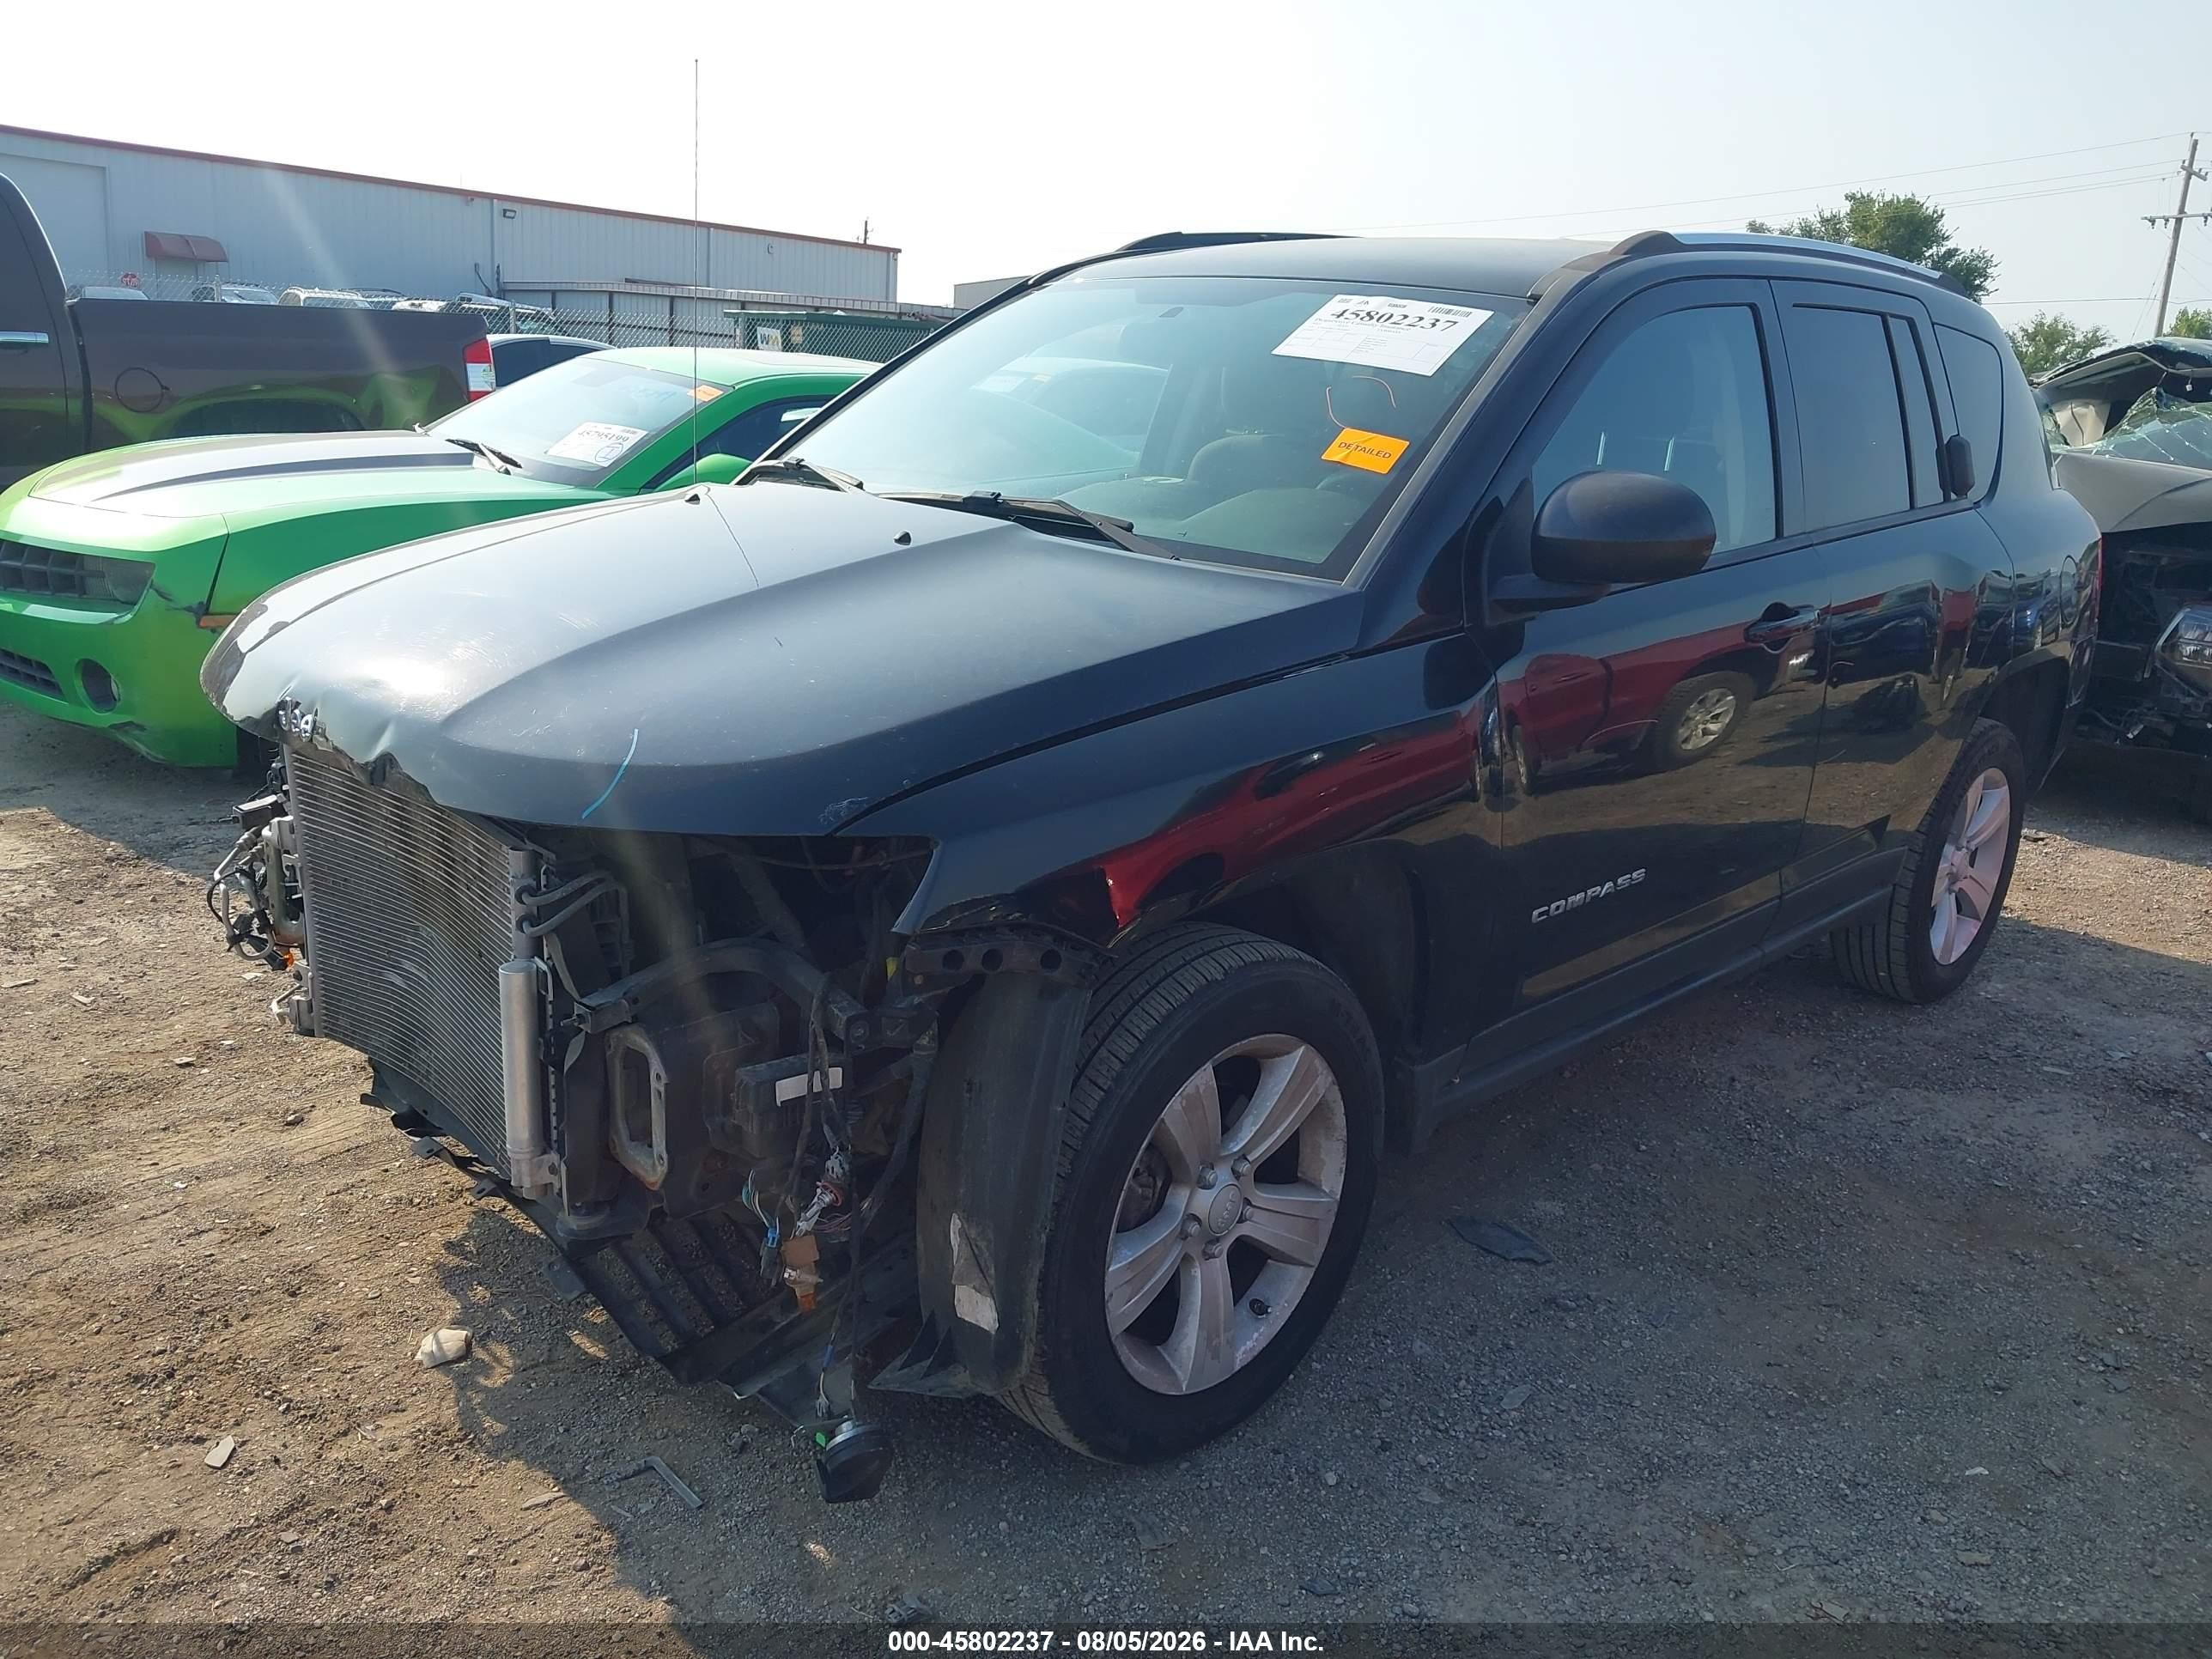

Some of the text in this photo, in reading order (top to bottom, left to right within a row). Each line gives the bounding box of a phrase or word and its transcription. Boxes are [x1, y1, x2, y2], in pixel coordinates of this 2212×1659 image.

[1331, 307, 1459, 332] 45802237
[1338, 441, 1392, 459] DETAILED
[1531, 868, 1646, 924] COMPASS
